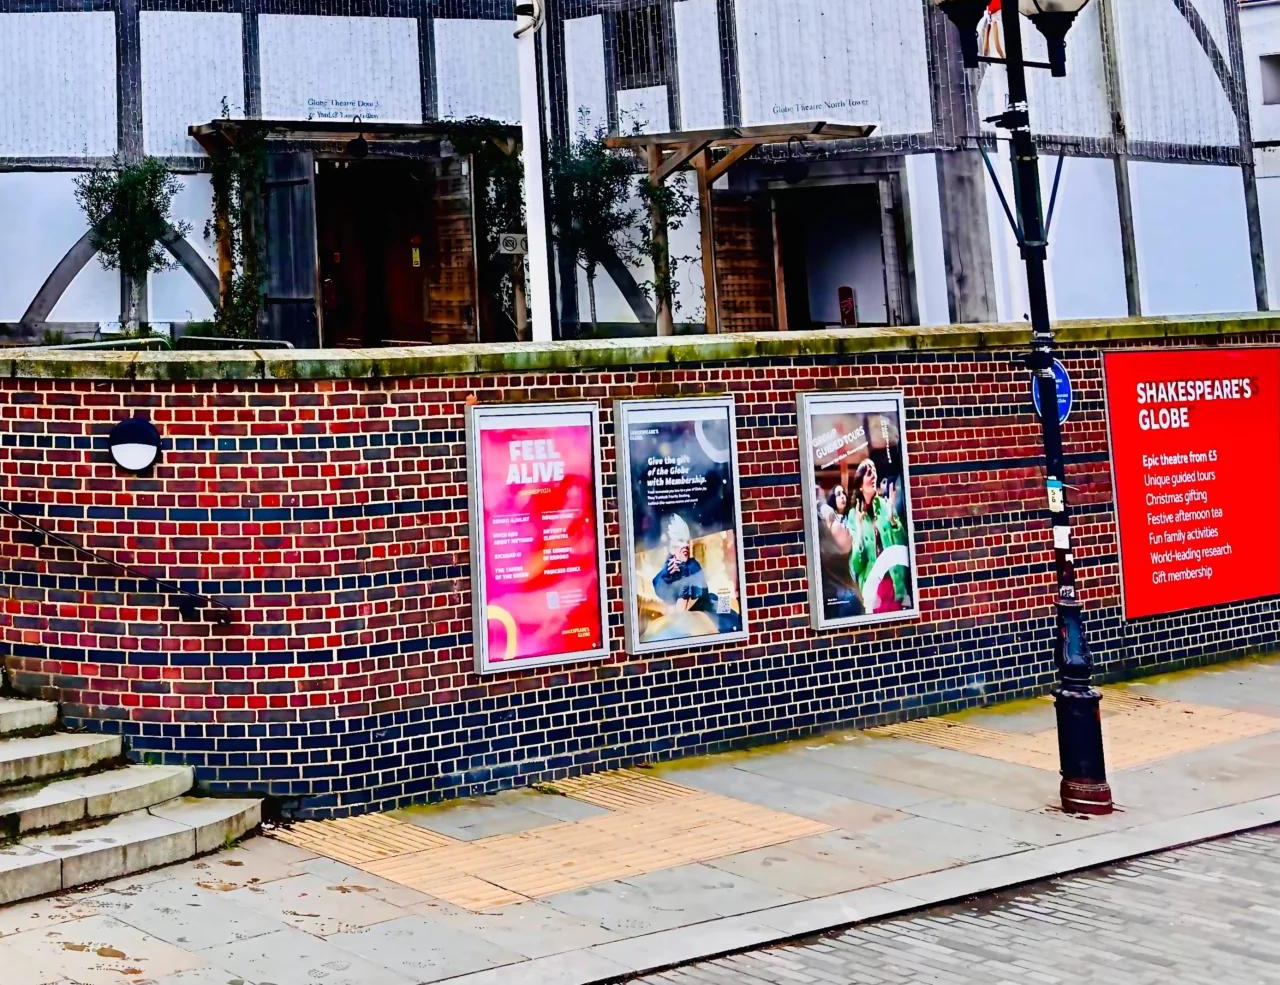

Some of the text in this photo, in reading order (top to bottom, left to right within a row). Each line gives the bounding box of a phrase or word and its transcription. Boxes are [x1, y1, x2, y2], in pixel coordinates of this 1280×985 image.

[1136, 378, 1252, 404] SHAKESPEARE'S
[1138, 407, 1190, 430] GLOBE
[812, 428, 837, 447] GROUP
[816, 438, 844, 459] GUIDED
[842, 426, 865, 444] TOURS
[509, 438, 561, 461] FEEL
[648, 455, 691, 466] Give the gift
[1142, 450, 1217, 469] Epic theatre from £5
[506, 461, 565, 485] ALIVE
[647, 466, 689, 477] of the Globe
[647, 475, 707, 486] with Membership.
[1144, 470, 1216, 488] Unique guided tours
[1146, 489, 1207, 506] Christmas gifting
[1147, 507, 1223, 525] Festive afternoon tea
[1149, 526, 1218, 545] Fun family activities
[1150, 543, 1232, 564] World-leading research
[1152, 565, 1212, 584] Gift membership
